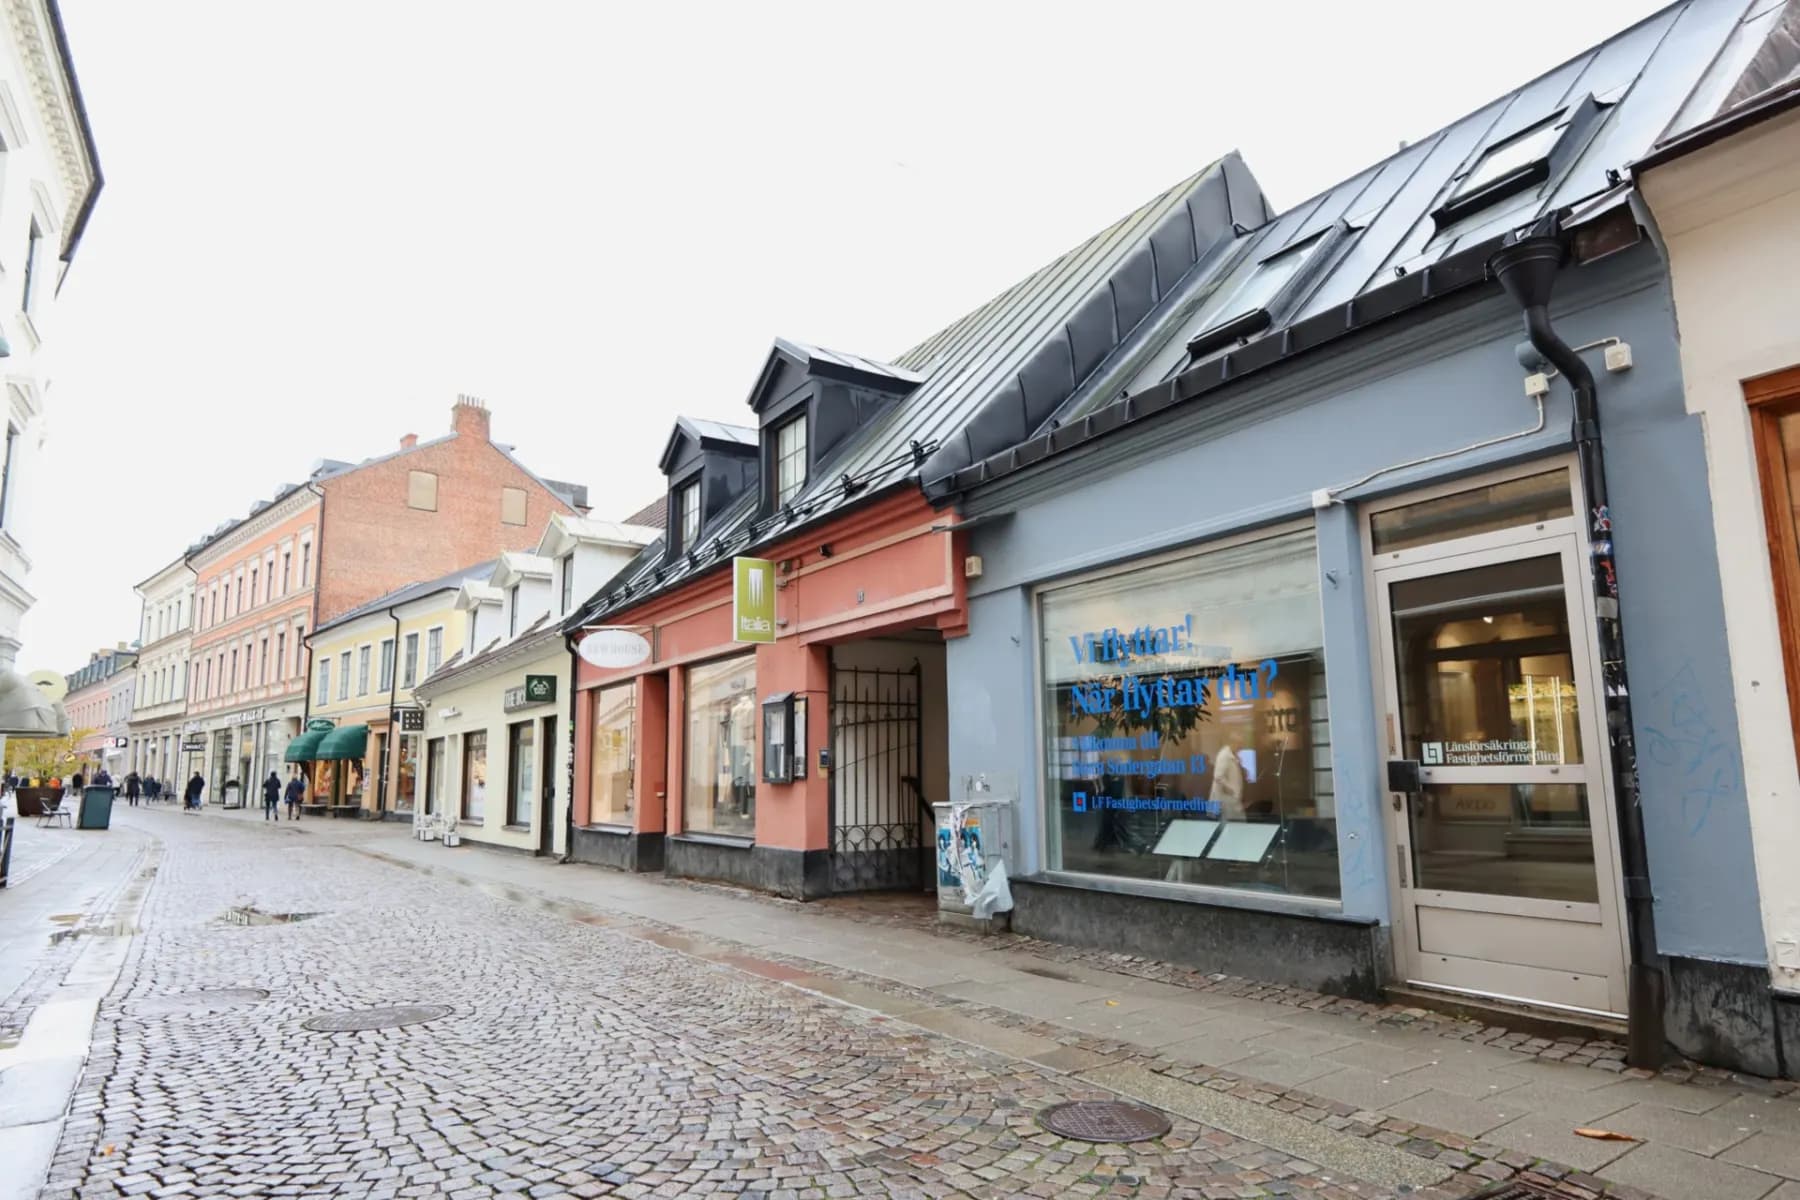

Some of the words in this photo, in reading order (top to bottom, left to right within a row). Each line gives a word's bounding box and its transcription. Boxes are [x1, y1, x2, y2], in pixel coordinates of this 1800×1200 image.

[741, 615, 770, 632] Italia
[1068, 632, 1095, 664] Vi
[1102, 614, 1192, 668] flyttar!
[1071, 680, 1116, 716] När
[1121, 674, 1211, 719] flyttar
[1216, 659, 1278, 702] du?
[1445, 739, 1540, 753] Länsförsäkringar
[1106, 757, 1187, 779] Södergatan
[1106, 796, 1220, 816] Fastighetsförmedling
